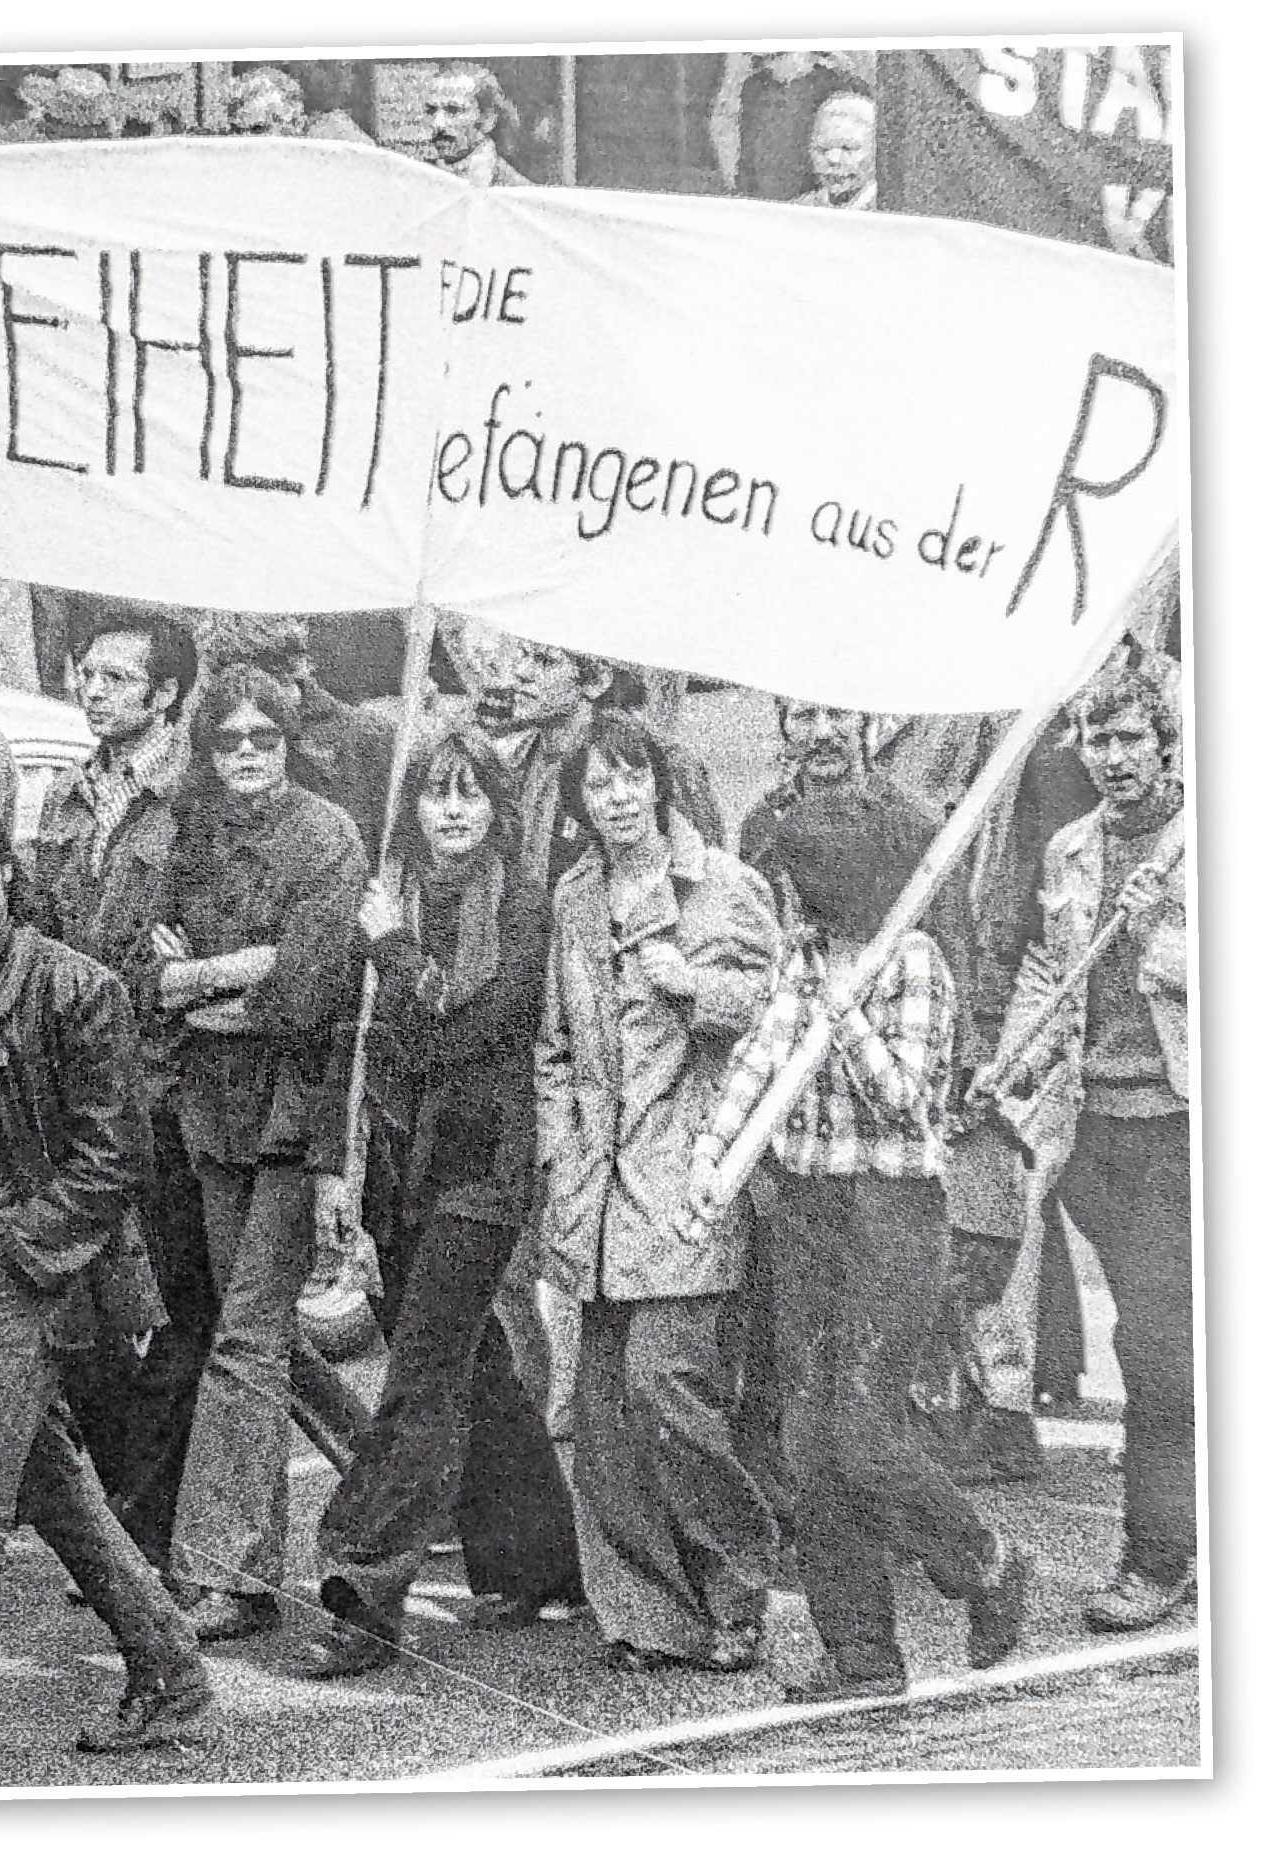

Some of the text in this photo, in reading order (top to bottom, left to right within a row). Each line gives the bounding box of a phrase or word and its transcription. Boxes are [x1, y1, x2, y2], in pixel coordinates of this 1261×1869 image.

[978, 47, 1172, 145] STA
[429, 382, 780, 542] efangenen
[811, 501, 899, 560] aus
[917, 483, 1006, 578] der
